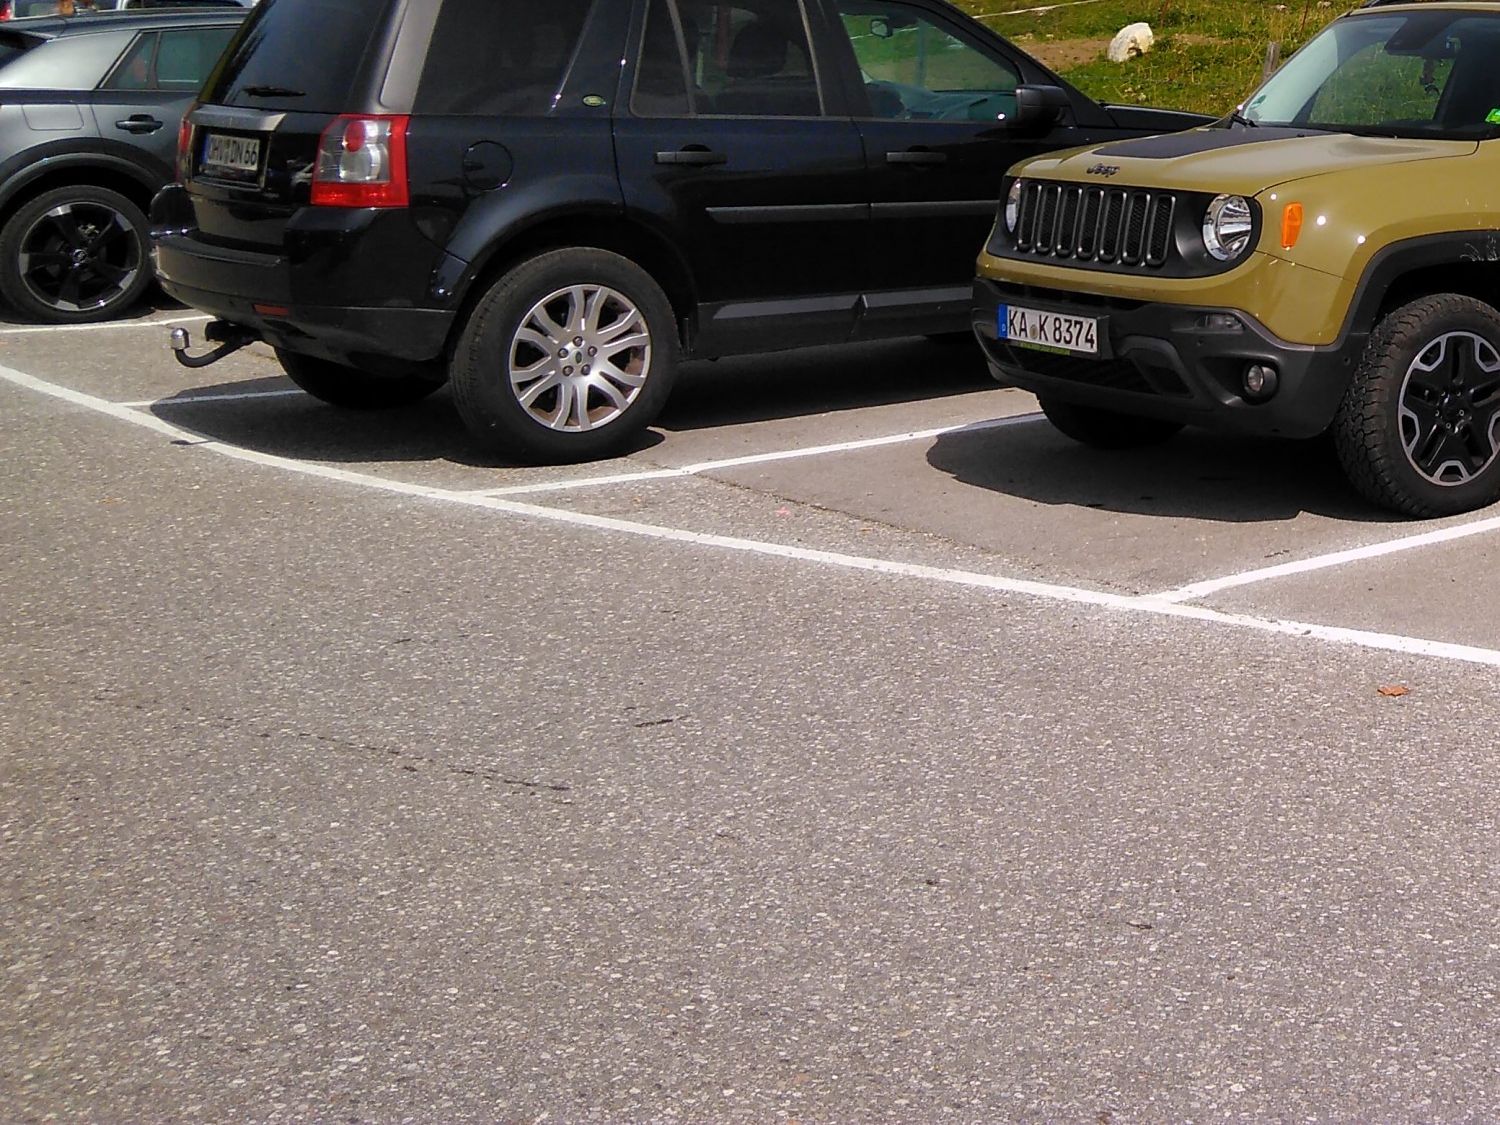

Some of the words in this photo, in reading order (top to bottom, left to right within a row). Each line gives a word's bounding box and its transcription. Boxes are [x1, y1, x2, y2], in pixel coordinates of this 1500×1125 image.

[244, 141, 258, 166] 66
[1086, 163, 1120, 178] Jeep
[1008, 309, 1029, 339] KA
[1038, 314, 1050, 342] K
[1053, 317, 1096, 350] 8374
